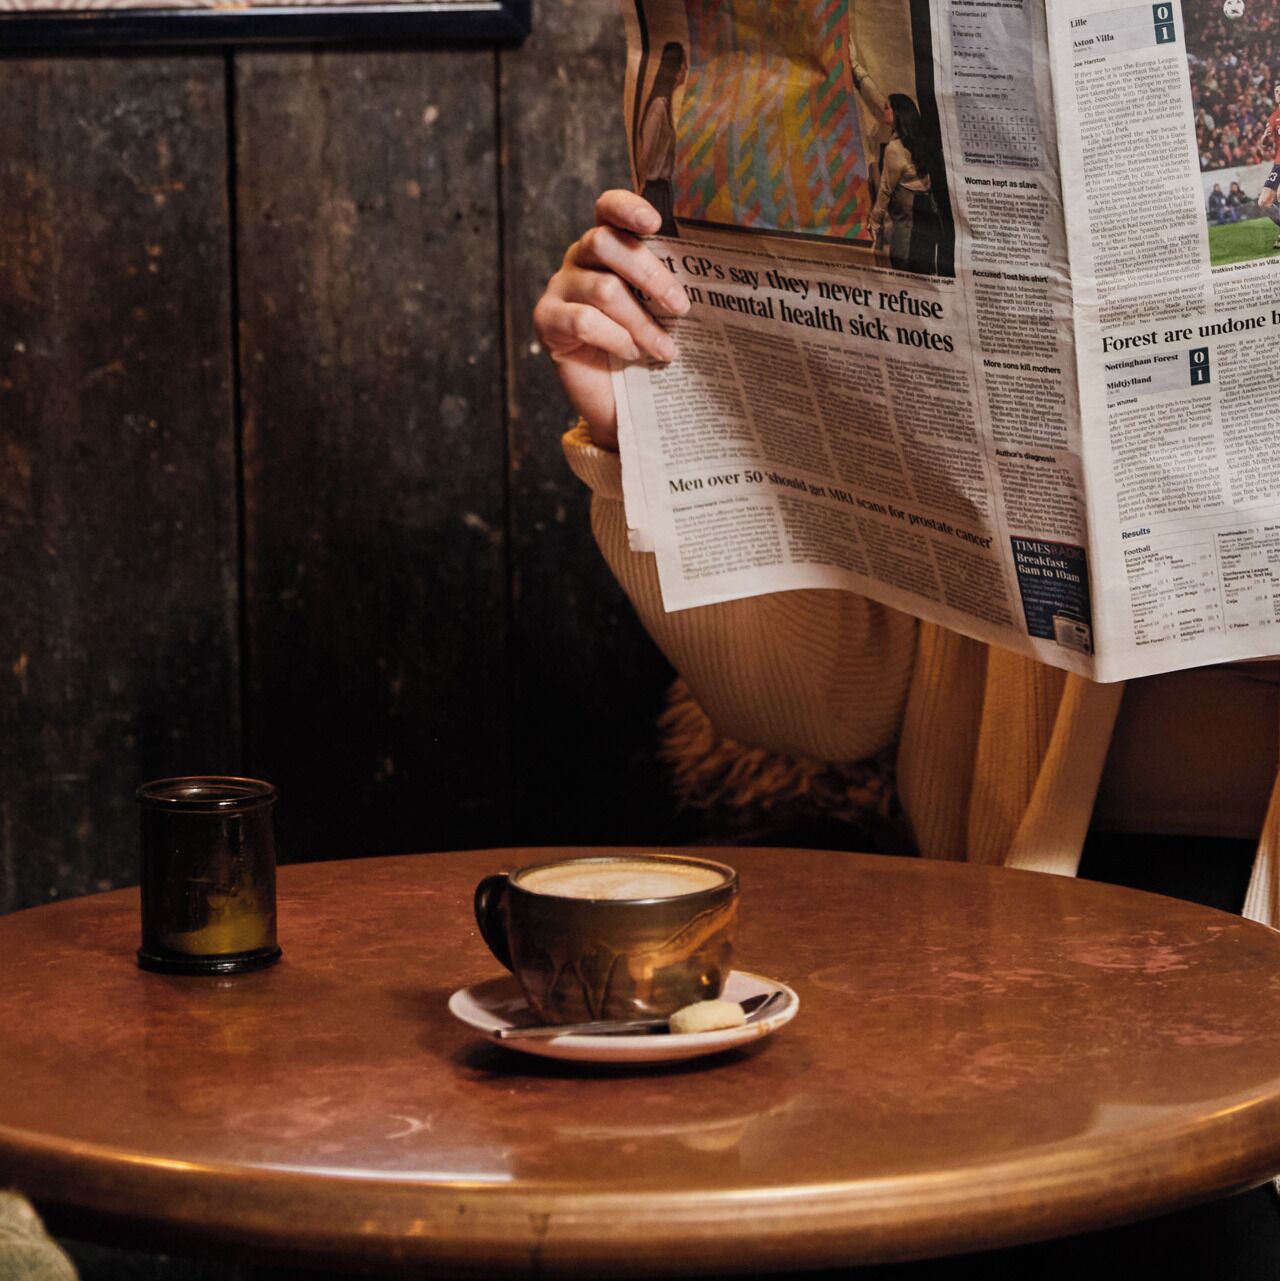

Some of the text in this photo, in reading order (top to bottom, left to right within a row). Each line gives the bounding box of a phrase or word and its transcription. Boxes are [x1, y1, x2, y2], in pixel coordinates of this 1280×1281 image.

[1070, 6, 1169, 29] Lille 0
[1073, 26, 1169, 49] Aston Villa 1
[1080, 72, 1092, 80] they
[1124, 62, 1133, 70] the
[1135, 61, 1156, 70] Europa
[1157, 57, 1178, 65] League
[1083, 57, 1106, 66] Harston
[964, 177, 991, 186] Woman
[992, 178, 1008, 188] kept
[1019, 180, 1037, 189] slave
[1211, 265, 1234, 275] Watkins
[1234, 262, 1252, 271] heads
[1266, 257, 1280, 266] Villa
[973, 269, 1001, 279] Accused
[1019, 274, 1030, 282] his
[682, 255, 725, 280] GPs
[728, 266, 759, 291] say
[766, 270, 810, 300] they
[816, 280, 873, 308] never
[879, 290, 944, 319] refuse
[707, 290, 775, 320] mental
[778, 299, 844, 333] health
[849, 314, 890, 342] sick
[896, 325, 954, 352] notes
[1101, 329, 1158, 353] Forest
[1164, 328, 1193, 343] are
[1199, 315, 1267, 338] undone
[983, 359, 1001, 368] More
[1003, 362, 1019, 370] sons
[1032, 365, 1061, 374] mothers
[1105, 351, 1205, 371] Nottingham Forest 0
[1106, 369, 1204, 390] Midtjylland 1
[1116, 397, 1138, 407] Whittell
[1024, 452, 1056, 463] diagnosis
[668, 475, 704, 495] Men
[707, 473, 742, 487] over
[744, 470, 763, 484] 50
[807, 484, 826, 499] get
[827, 487, 854, 506] MRI
[856, 497, 888, 515] scans
[888, 505, 905, 520] for
[908, 513, 955, 537] prostate
[1121, 528, 1151, 540] Results
[1013, 540, 1051, 554] TIMES
[1124, 545, 1151, 556] Football
[1016, 552, 1068, 569] Breakfast:
[1018, 564, 1080, 583] 6am to 10am
[1222, 569, 1250, 577] Conference
